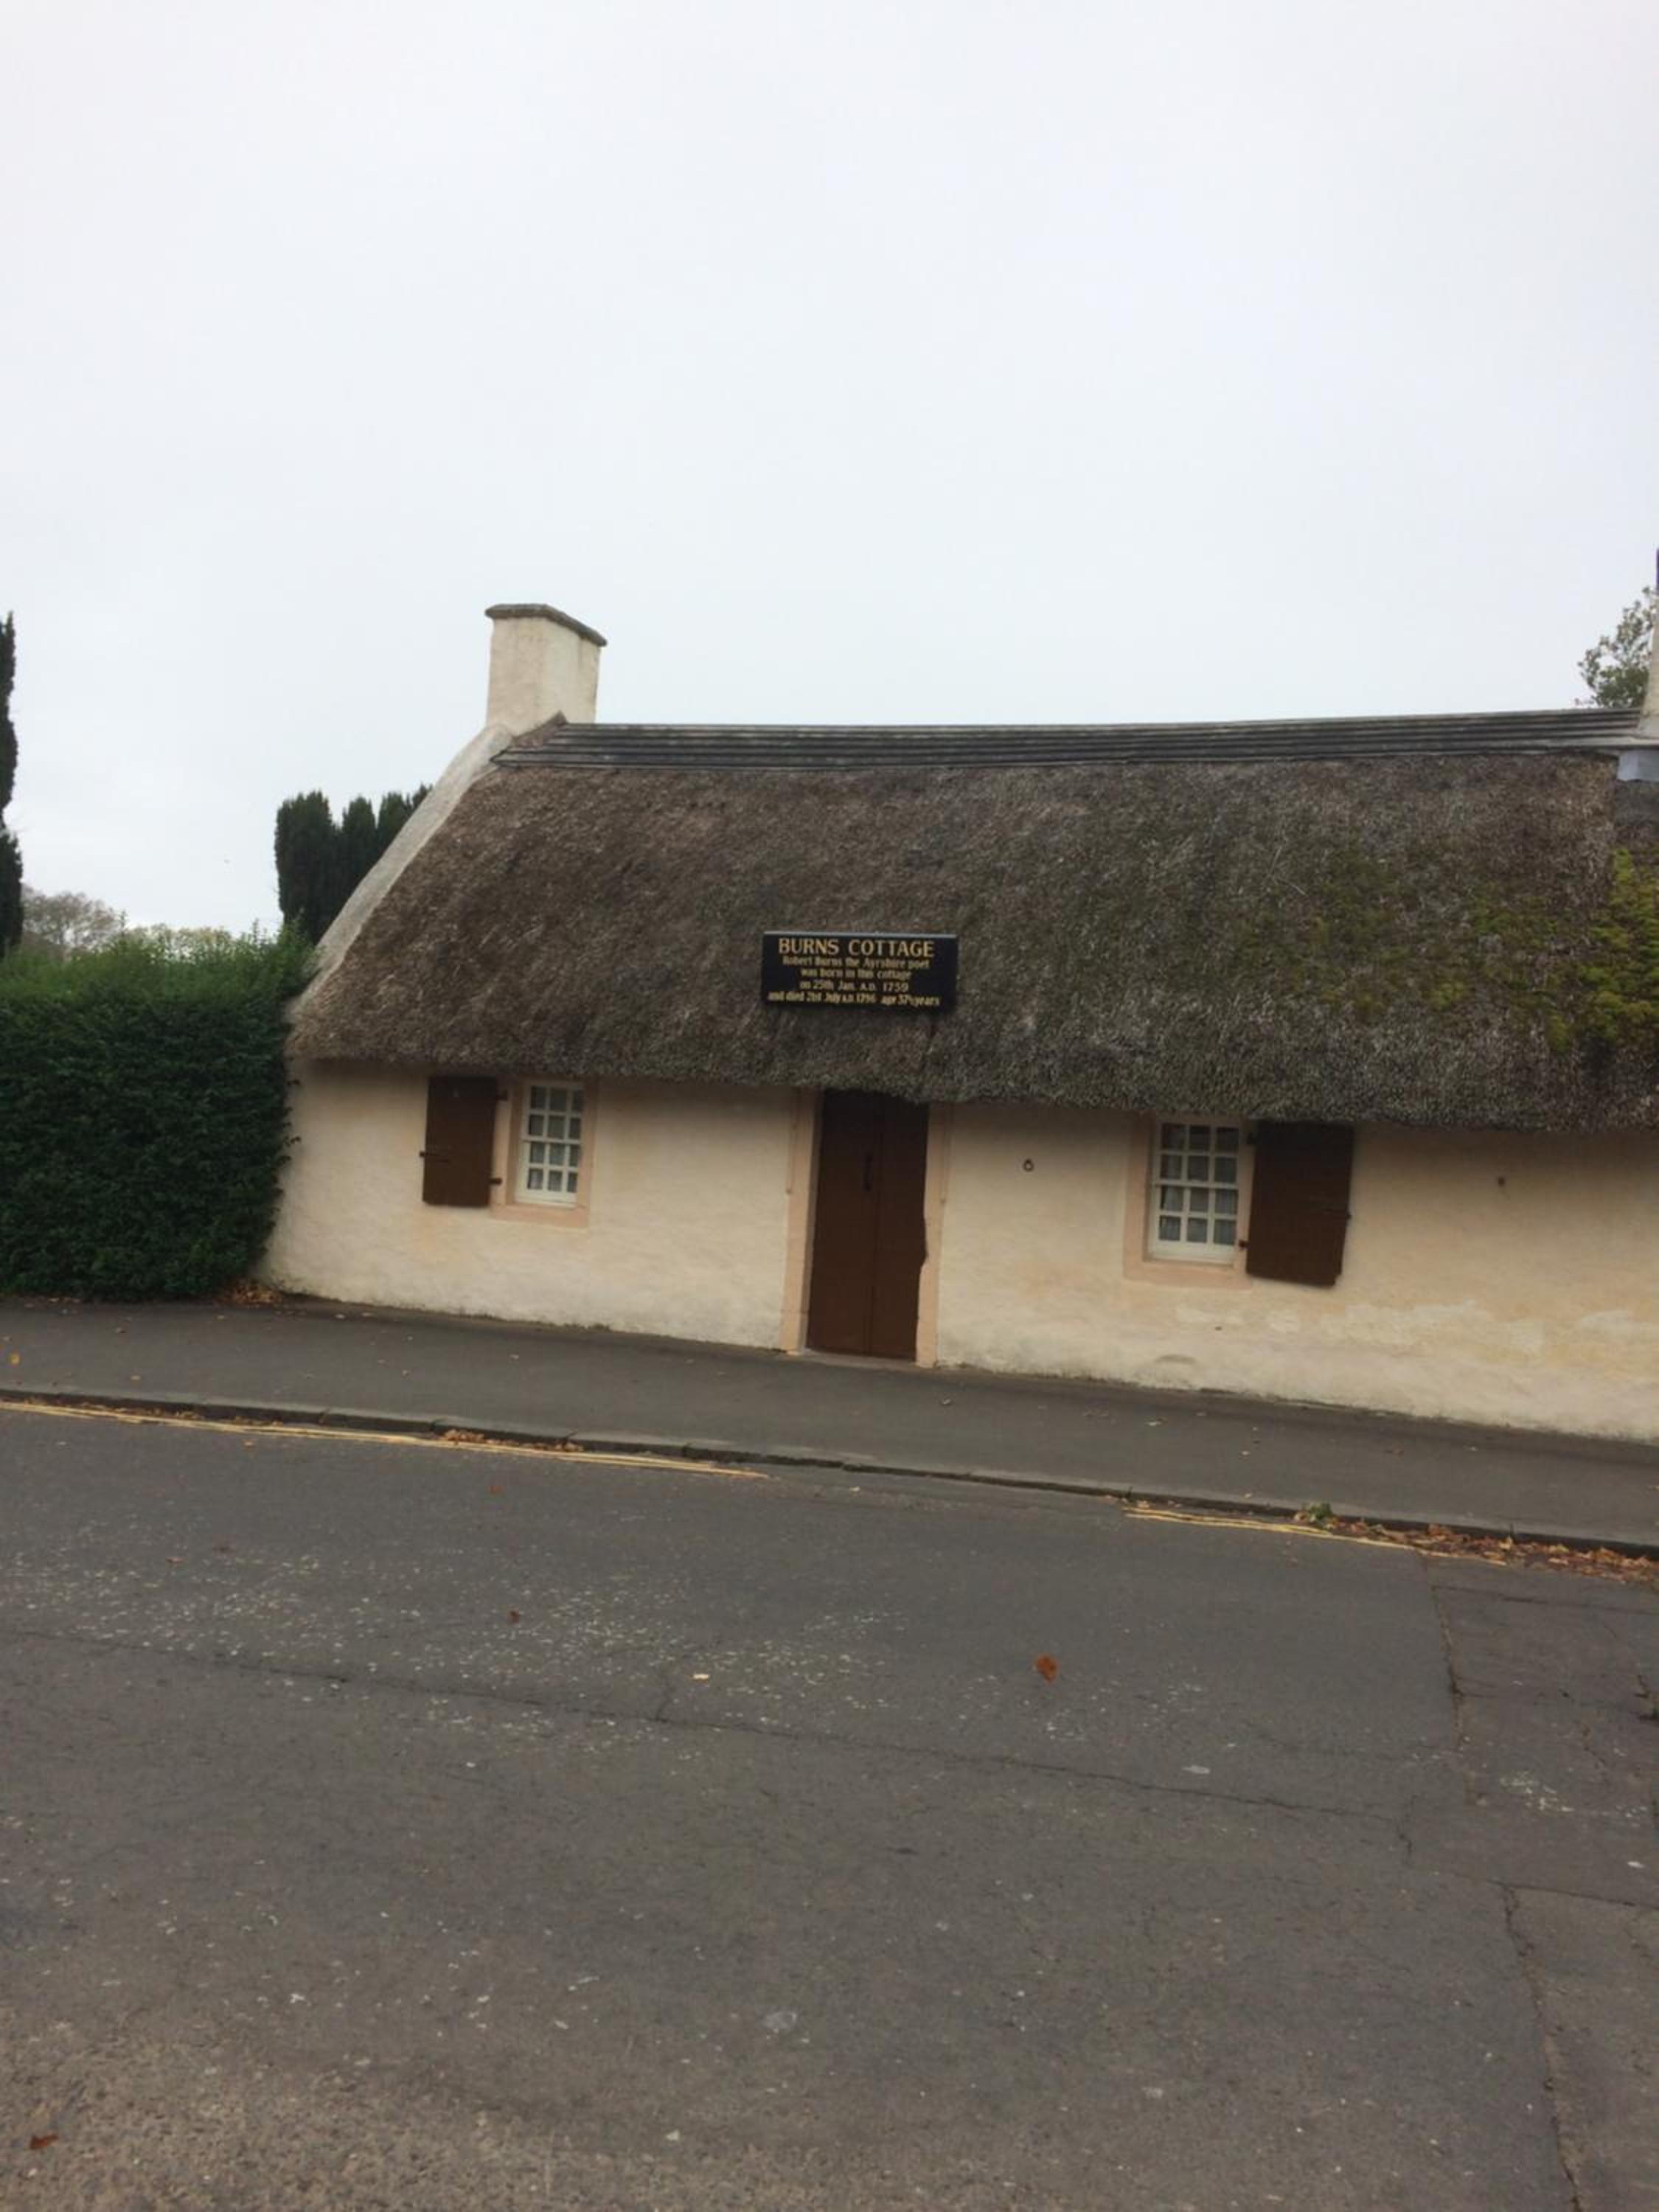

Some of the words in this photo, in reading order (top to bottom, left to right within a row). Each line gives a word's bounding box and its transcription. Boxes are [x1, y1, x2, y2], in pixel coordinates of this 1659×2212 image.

[778, 938, 839, 954] BURNS
[849, 939, 935, 957] COTTAGE
[863, 958, 905, 969] Ayrshire
[908, 959, 929, 970] poet
[820, 967, 843, 978] born
[877, 969, 911, 981] cottage
[883, 981, 909, 992] 1759
